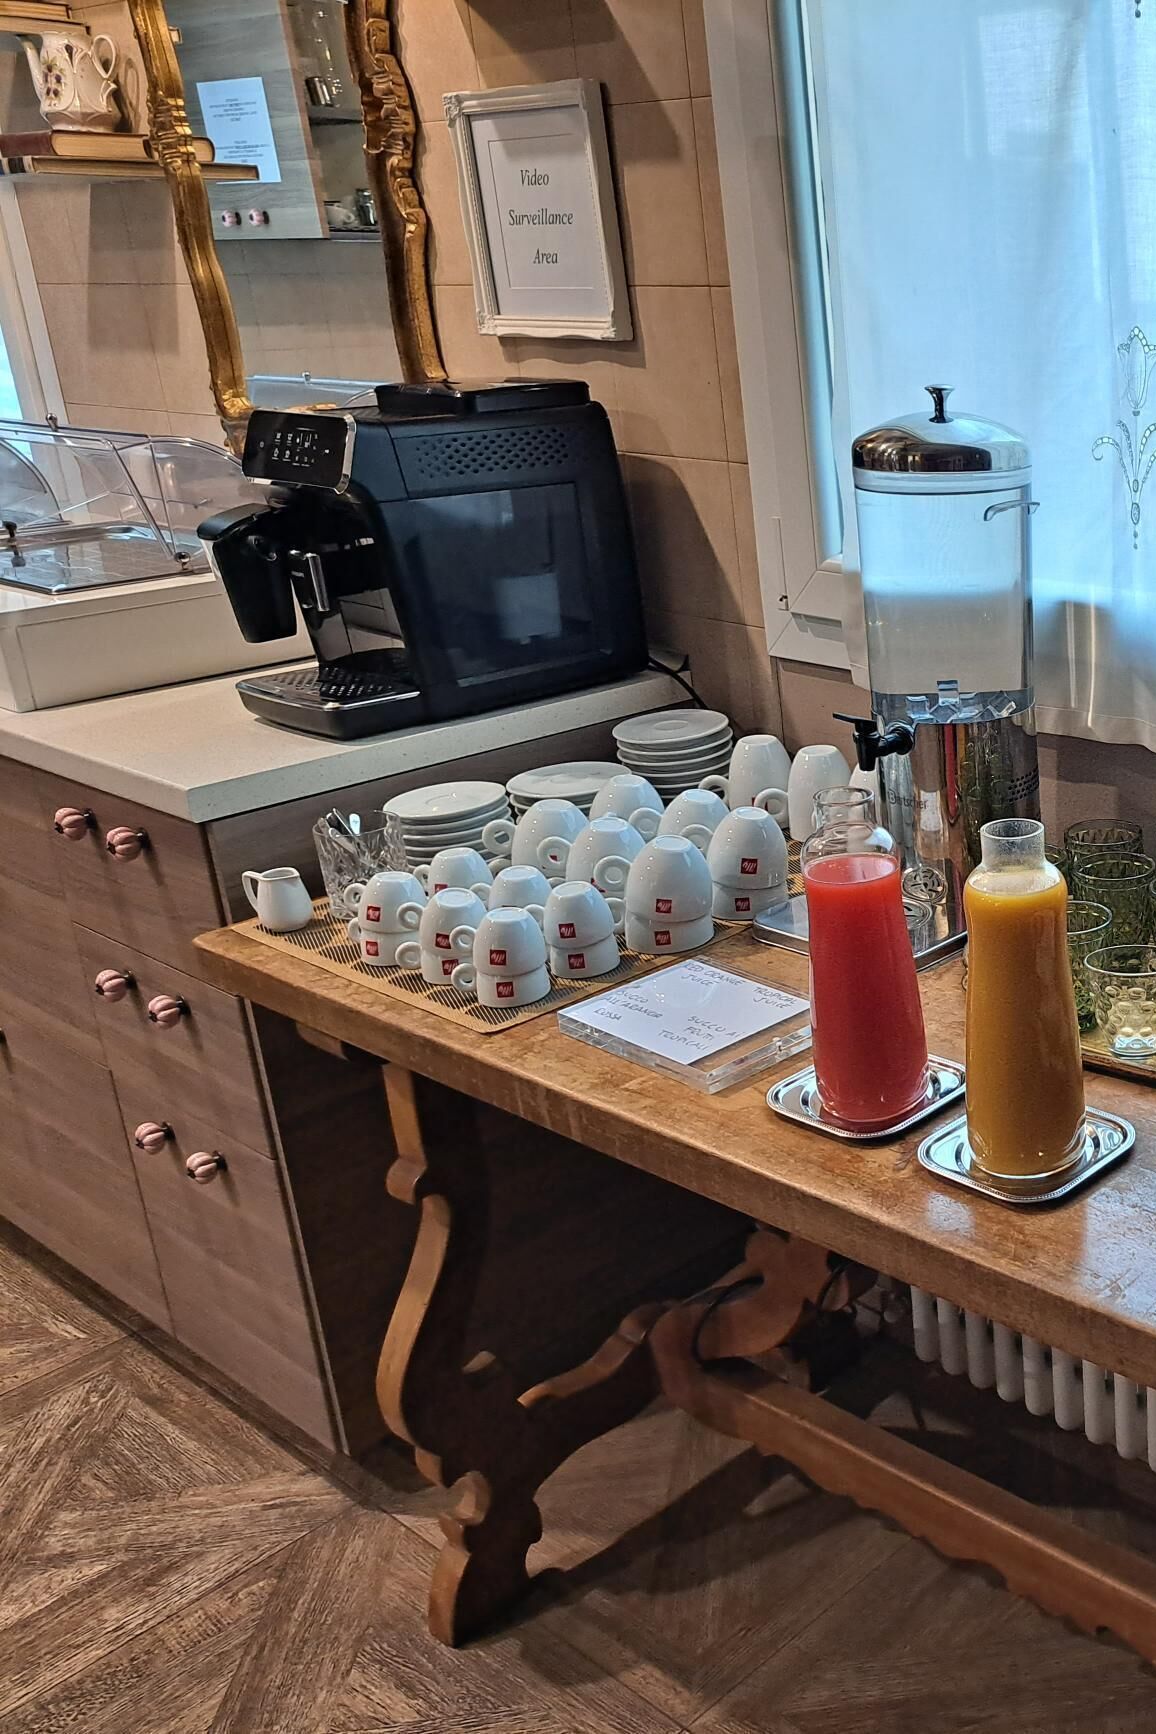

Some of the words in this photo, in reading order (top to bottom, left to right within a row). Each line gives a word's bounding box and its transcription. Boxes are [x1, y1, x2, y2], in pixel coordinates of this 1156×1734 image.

[520, 168, 550, 187] Video
[508, 208, 574, 227] Surveillance
[533, 248, 559, 265] Area
[741, 860, 758, 873] illy
[657, 901, 672, 912] illy
[736, 900, 749, 911] illy
[560, 926, 575, 937] illy
[490, 952, 506, 964] illy
[681, 974, 720, 987] JUICE
[497, 984, 513, 995] illy
[752, 986, 798, 1005] TROPICAL
[752, 997, 792, 1009] JUICE
[687, 1015, 727, 1032] SUCCO
